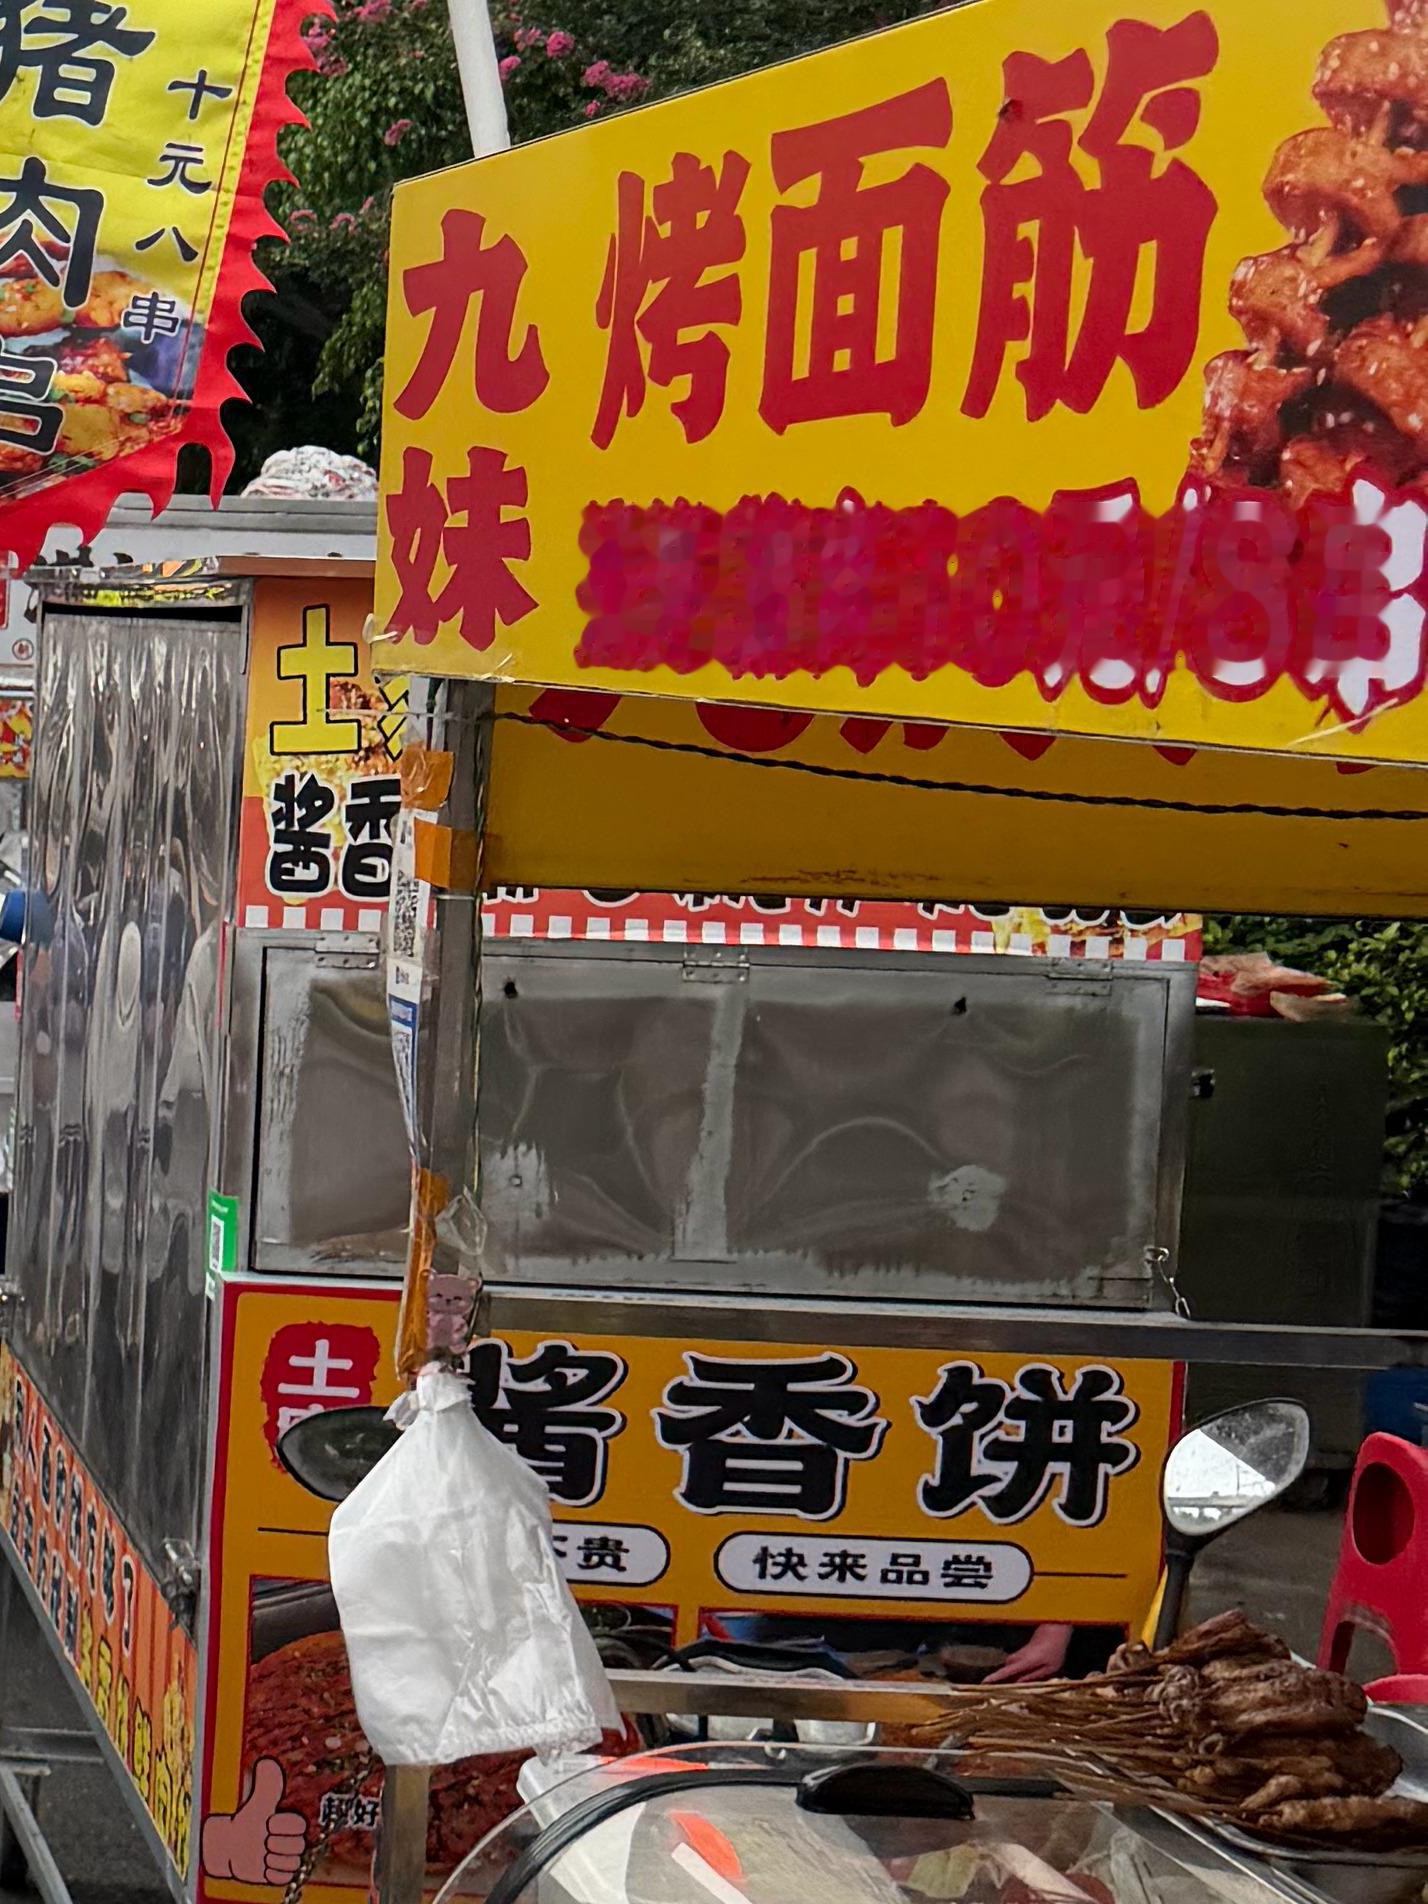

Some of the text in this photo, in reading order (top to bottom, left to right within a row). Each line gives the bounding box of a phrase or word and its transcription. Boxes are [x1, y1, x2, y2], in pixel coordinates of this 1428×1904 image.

[120, 67, 234, 346] 十元八串
[590, 11, 1219, 450] 烤面筋
[381, 208, 551, 651] 九妹
[461, 1337, 1142, 1529] 酱香饼
[752, 1543, 995, 1591] 快来品尝
